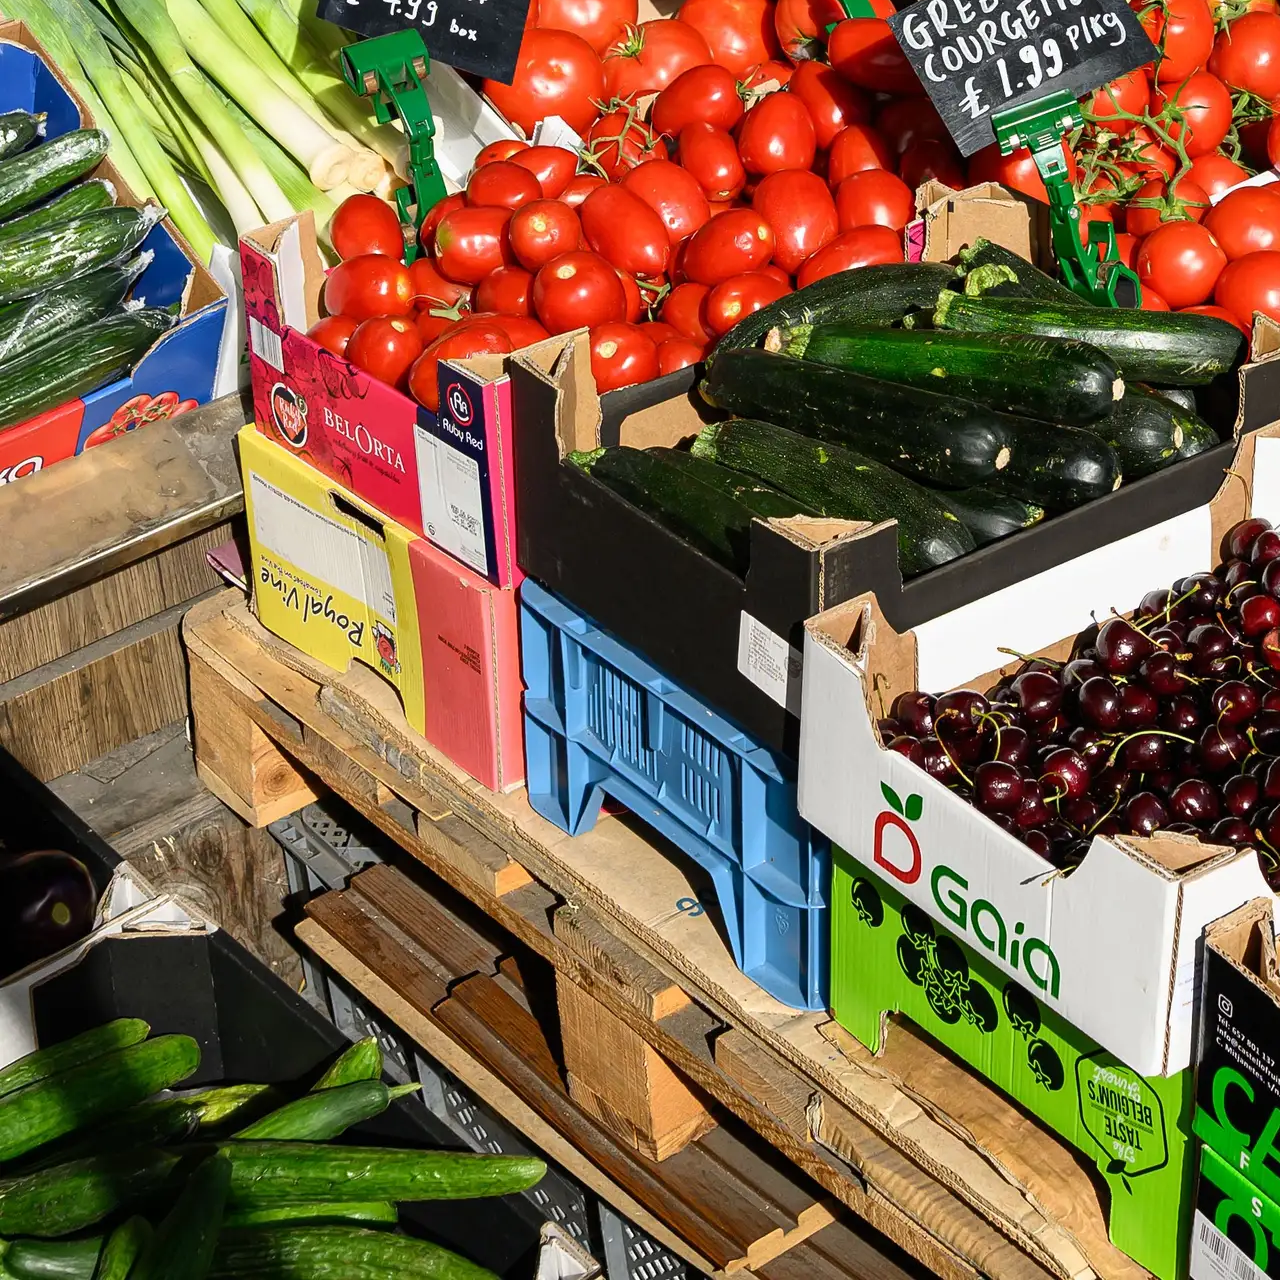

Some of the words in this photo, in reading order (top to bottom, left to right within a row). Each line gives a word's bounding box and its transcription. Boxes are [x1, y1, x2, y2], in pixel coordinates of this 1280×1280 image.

[450, 18, 477, 42] box
[957, 37, 1065, 120] £1.99
[322, 406, 407, 474] BELORTA
[441, 417, 465, 443] Ruby
[465, 429, 484, 452] Red
[259, 564, 299, 609] Vine
[302, 593, 364, 647] Royal
[930, 864, 1062, 1002] Gaia
[1231, 1026, 1246, 1042] 657
[1246, 1037, 1260, 1056] 801
[1261, 1050, 1276, 1068] 137
[1087, 1078, 1152, 1127] BELGIUM'S
[1103, 1114, 1143, 1151] TASTE
